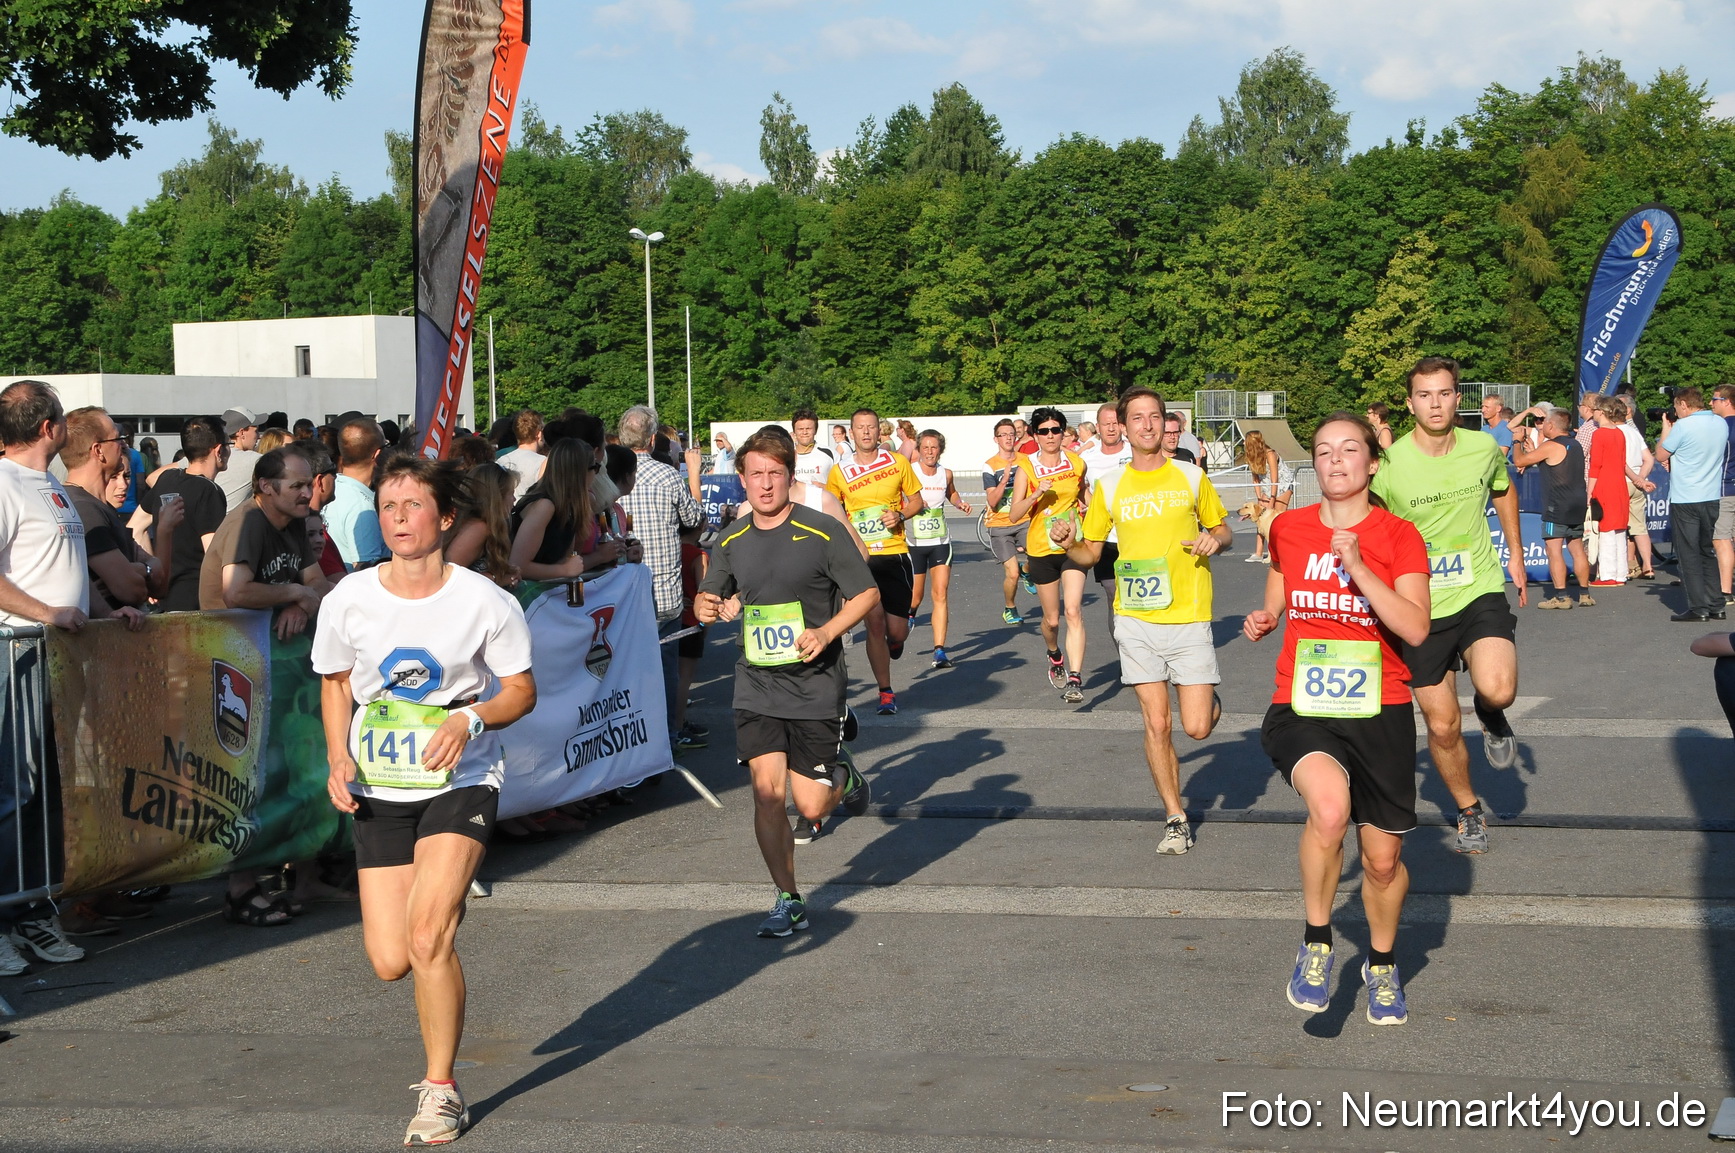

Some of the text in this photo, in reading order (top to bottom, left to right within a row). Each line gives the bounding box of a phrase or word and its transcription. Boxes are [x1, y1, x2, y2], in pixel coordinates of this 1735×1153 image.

[1630, 279, 1648, 306] Druck
[1655, 228, 1674, 261] Mdien
[1584, 261, 1652, 367] Frischmann
[848, 467, 900, 493] MAX BÖGL
[1119, 489, 1189, 506] MAGNA STEYR
[1410, 482, 1483, 508] globalconcepts
[1120, 498, 1189, 523] RUN 2014
[858, 518, 886, 535] 823
[918, 518, 941, 531] 553
[1123, 576, 1162, 598] 732
[1291, 590, 1370, 613] MEIER
[1289, 609, 1379, 627] Running Team
[752, 625, 795, 651] 109
[1305, 667, 1367, 698] 852
[222, 730, 240, 748] 1628
[564, 712, 648, 774] Lammsbräu
